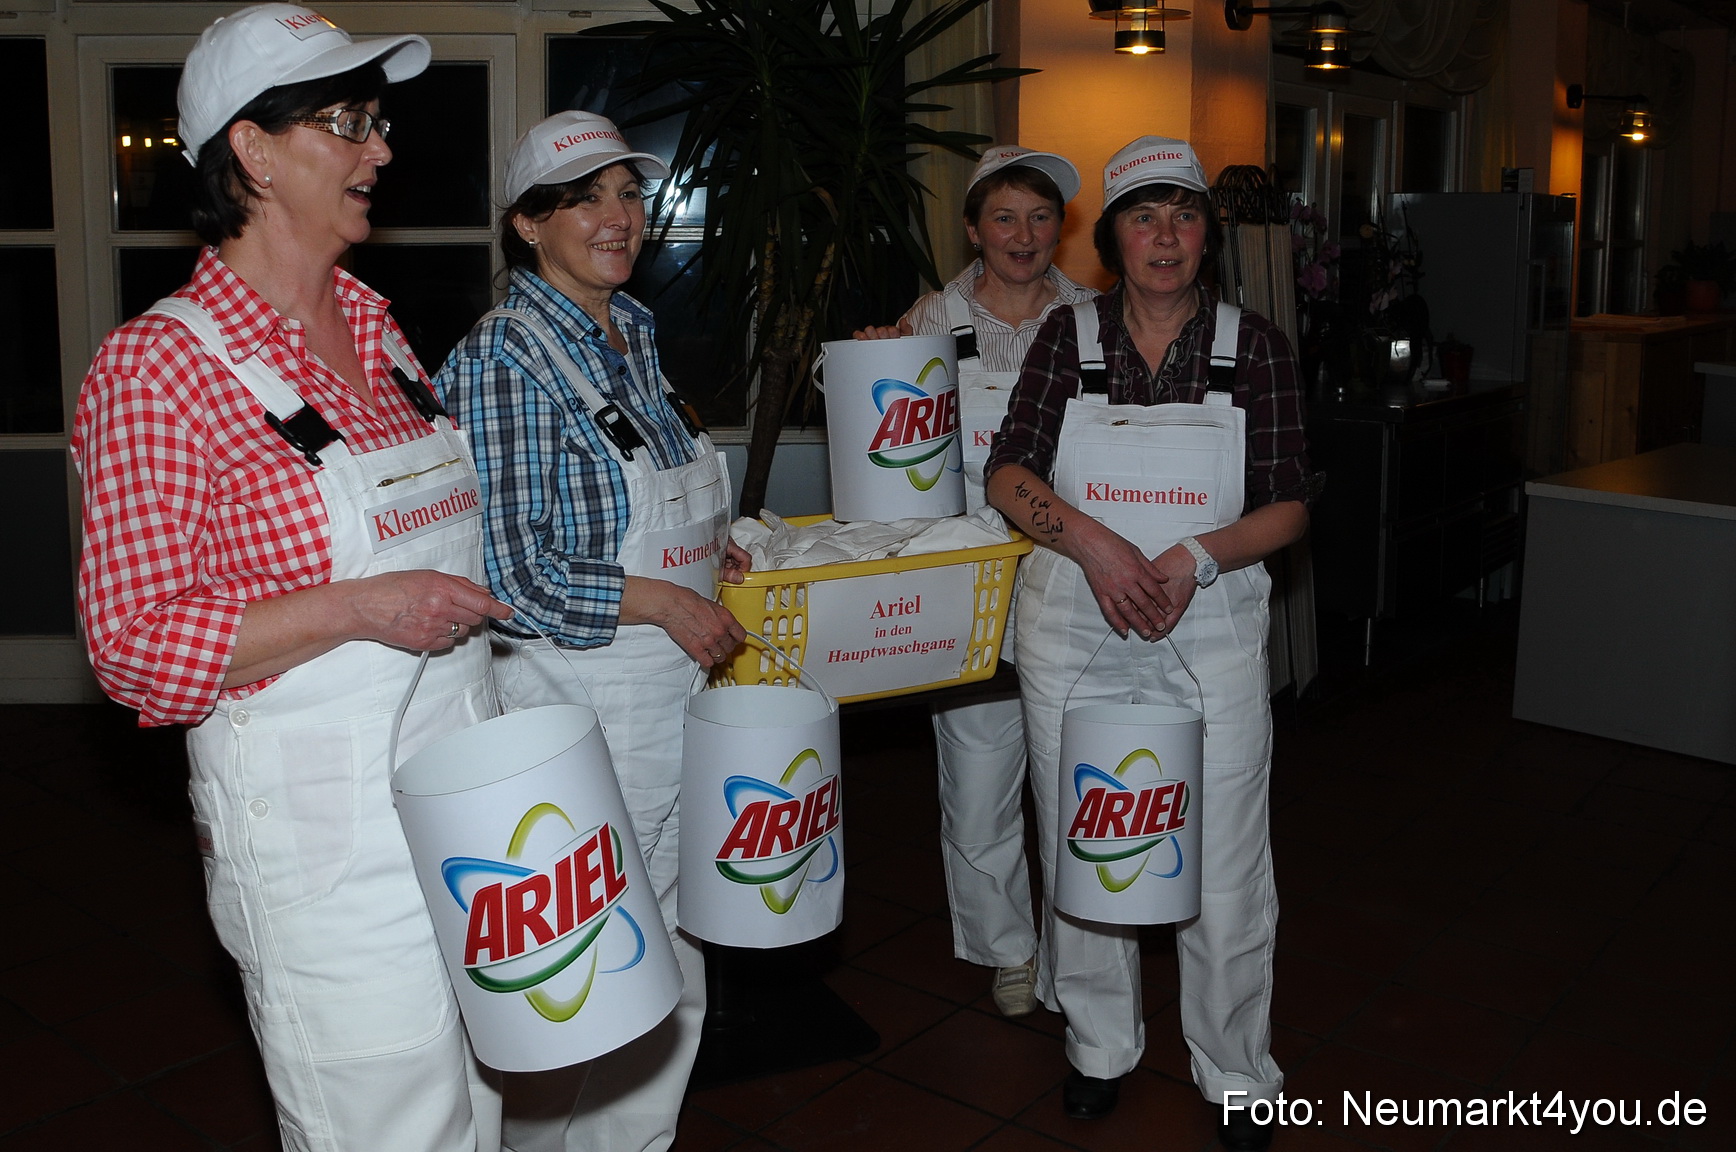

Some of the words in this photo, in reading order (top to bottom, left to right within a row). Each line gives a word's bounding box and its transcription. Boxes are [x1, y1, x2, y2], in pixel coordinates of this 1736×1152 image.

[1110, 150, 1183, 180] Klementine
[1085, 482, 1208, 506] Klementine
[372, 487, 479, 542] Klementine
[869, 594, 921, 620] Ariel
[874, 627, 886, 638] in
[890, 625, 912, 636] den
[827, 637, 957, 664] Hauptwaschgang
[715, 774, 840, 860] ARIEL
[1067, 780, 1186, 839] ARIEL
[463, 821, 628, 966] ARIEL
